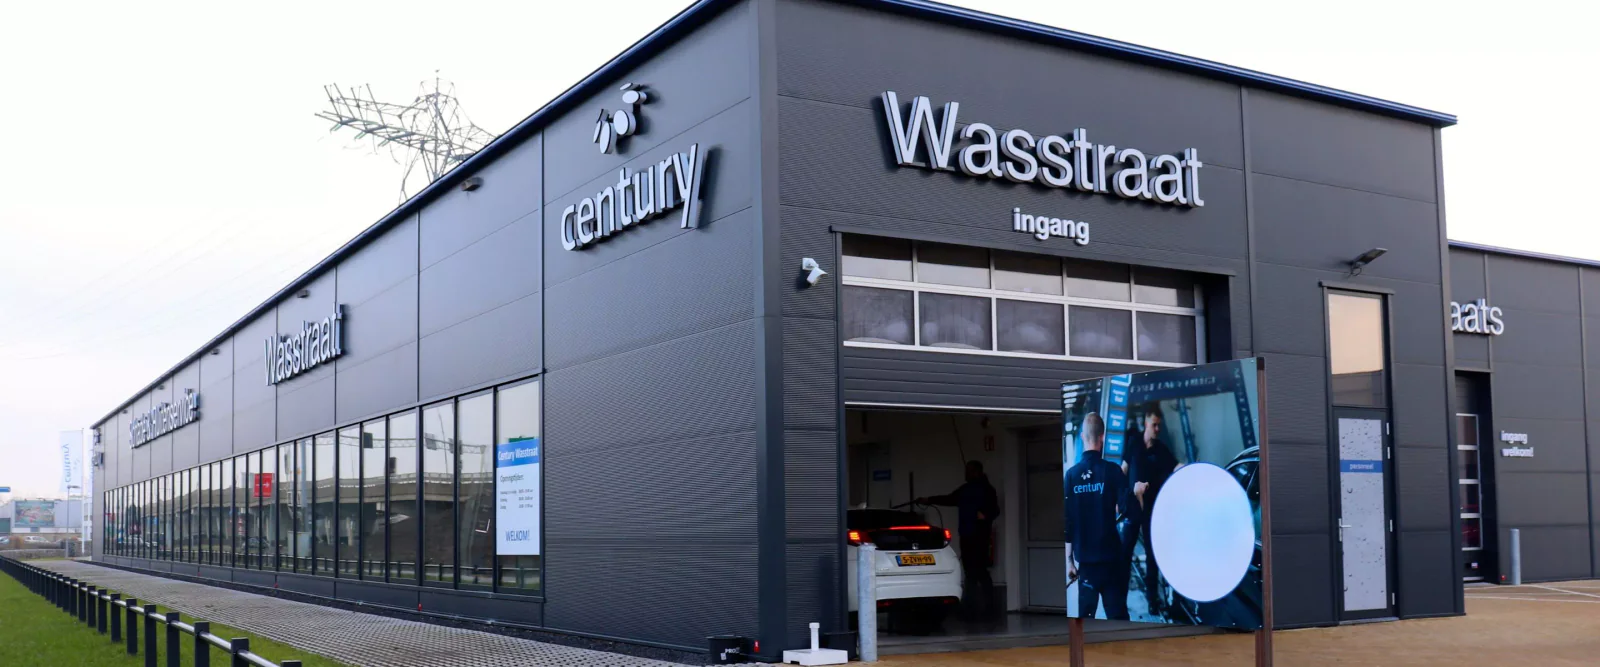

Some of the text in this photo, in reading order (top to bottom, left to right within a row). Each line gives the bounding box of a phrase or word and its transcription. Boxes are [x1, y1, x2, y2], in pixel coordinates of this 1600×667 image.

[881, 90, 1204, 207] Wasstraat
[561, 143, 702, 251] century
[1013, 207, 1089, 245] ingang
[264, 302, 342, 386] Wasstraat
[1500, 431, 1527, 444] ingang
[498, 446, 538, 461] Century Wasstraat
[1073, 481, 1105, 495] century
[505, 530, 530, 542] WELKOM!
